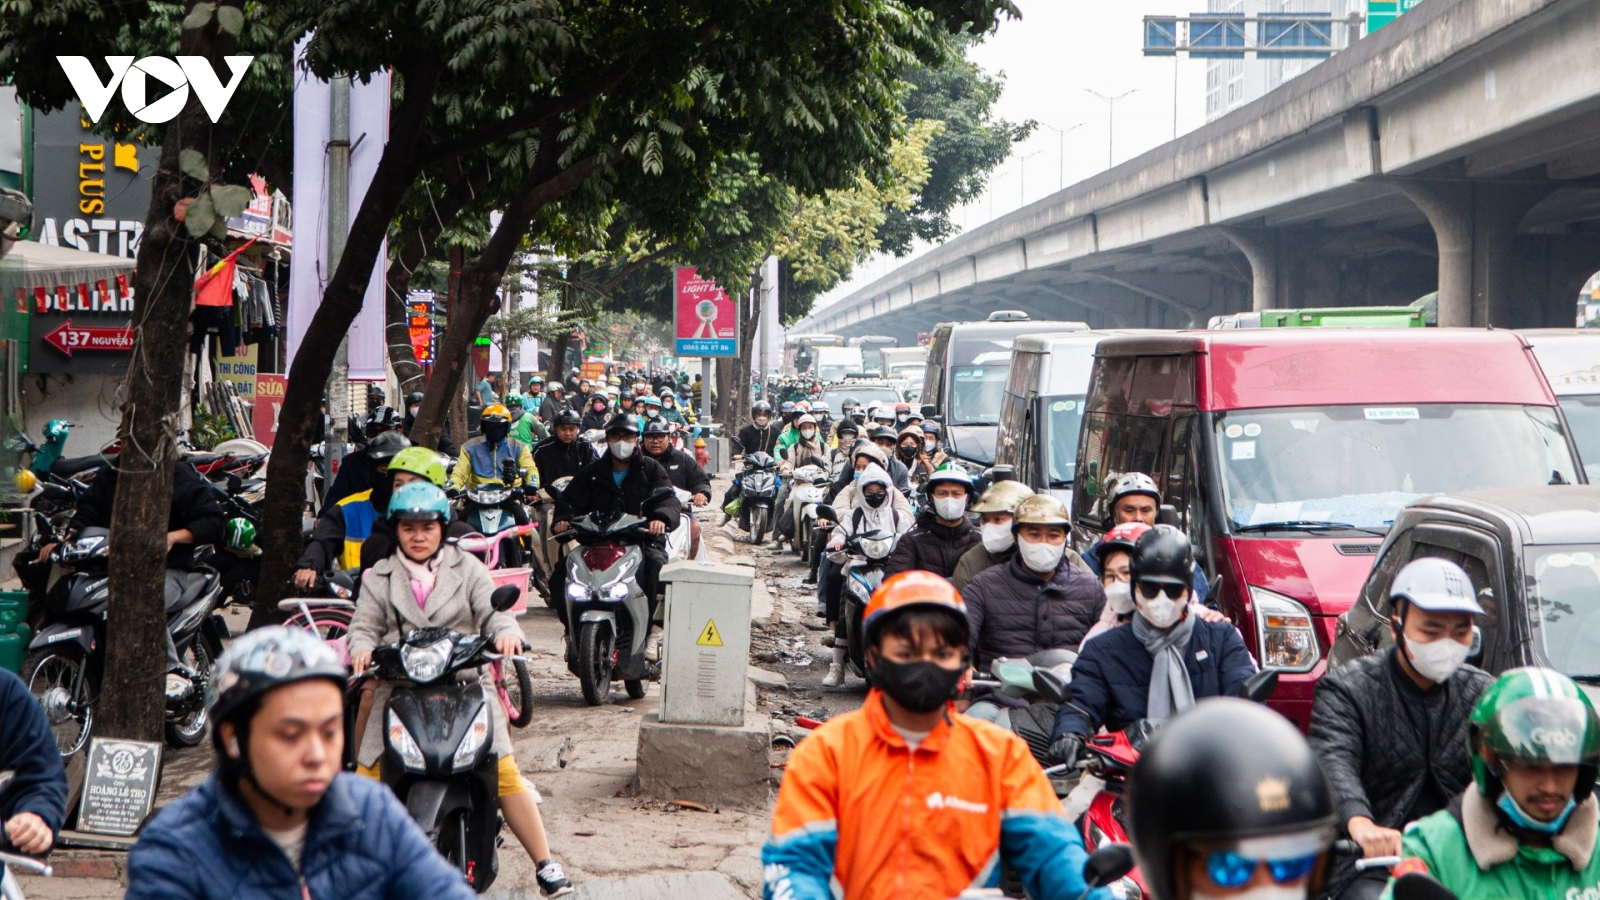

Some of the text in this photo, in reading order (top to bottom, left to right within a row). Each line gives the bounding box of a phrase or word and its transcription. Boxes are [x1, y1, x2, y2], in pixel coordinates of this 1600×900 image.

[79, 142, 105, 214] PLUS
[682, 284, 710, 293] LIGHT
[59, 331, 91, 346] 137
[92, 332, 129, 346] NGUYỄN
[219, 361, 256, 375] THI CÔNG
[237, 381, 253, 395] ĐẶT
[257, 378, 284, 396] SỬA
[1530, 727, 1577, 747] Grab
[90, 784, 117, 796] HOÀNG
